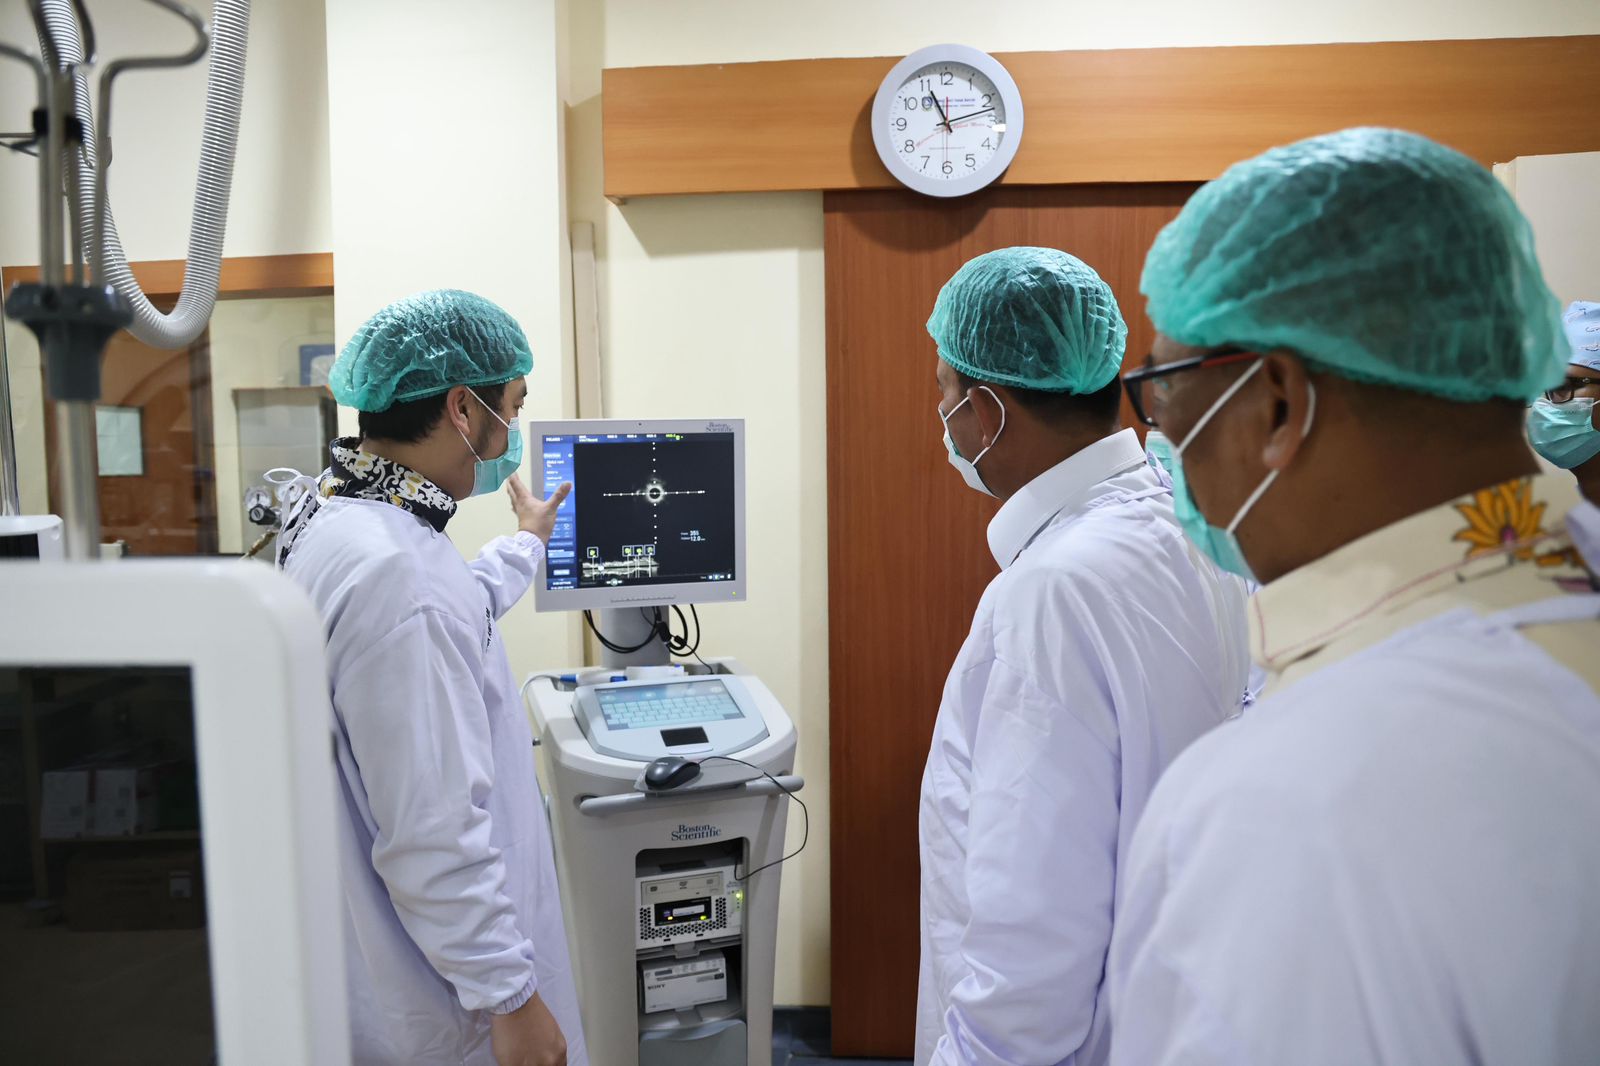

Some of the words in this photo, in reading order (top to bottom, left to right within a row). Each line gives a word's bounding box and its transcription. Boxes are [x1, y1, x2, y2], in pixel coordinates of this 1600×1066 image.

[920, 78, 931, 92] 11
[940, 72, 954, 85] 12
[968, 78, 973, 91] 1
[903, 96, 918, 111] 10
[981, 94, 992, 108] 2
[896, 117, 907, 131] 9
[987, 114, 998, 129] 3
[904, 139, 915, 153] 8
[981, 137, 991, 150] 4
[920, 155, 930, 169] 7
[941, 160, 953, 175] 6
[965, 153, 976, 168] 5
[671, 826, 721, 841] Scientific
[678, 824, 710, 834] Boston
